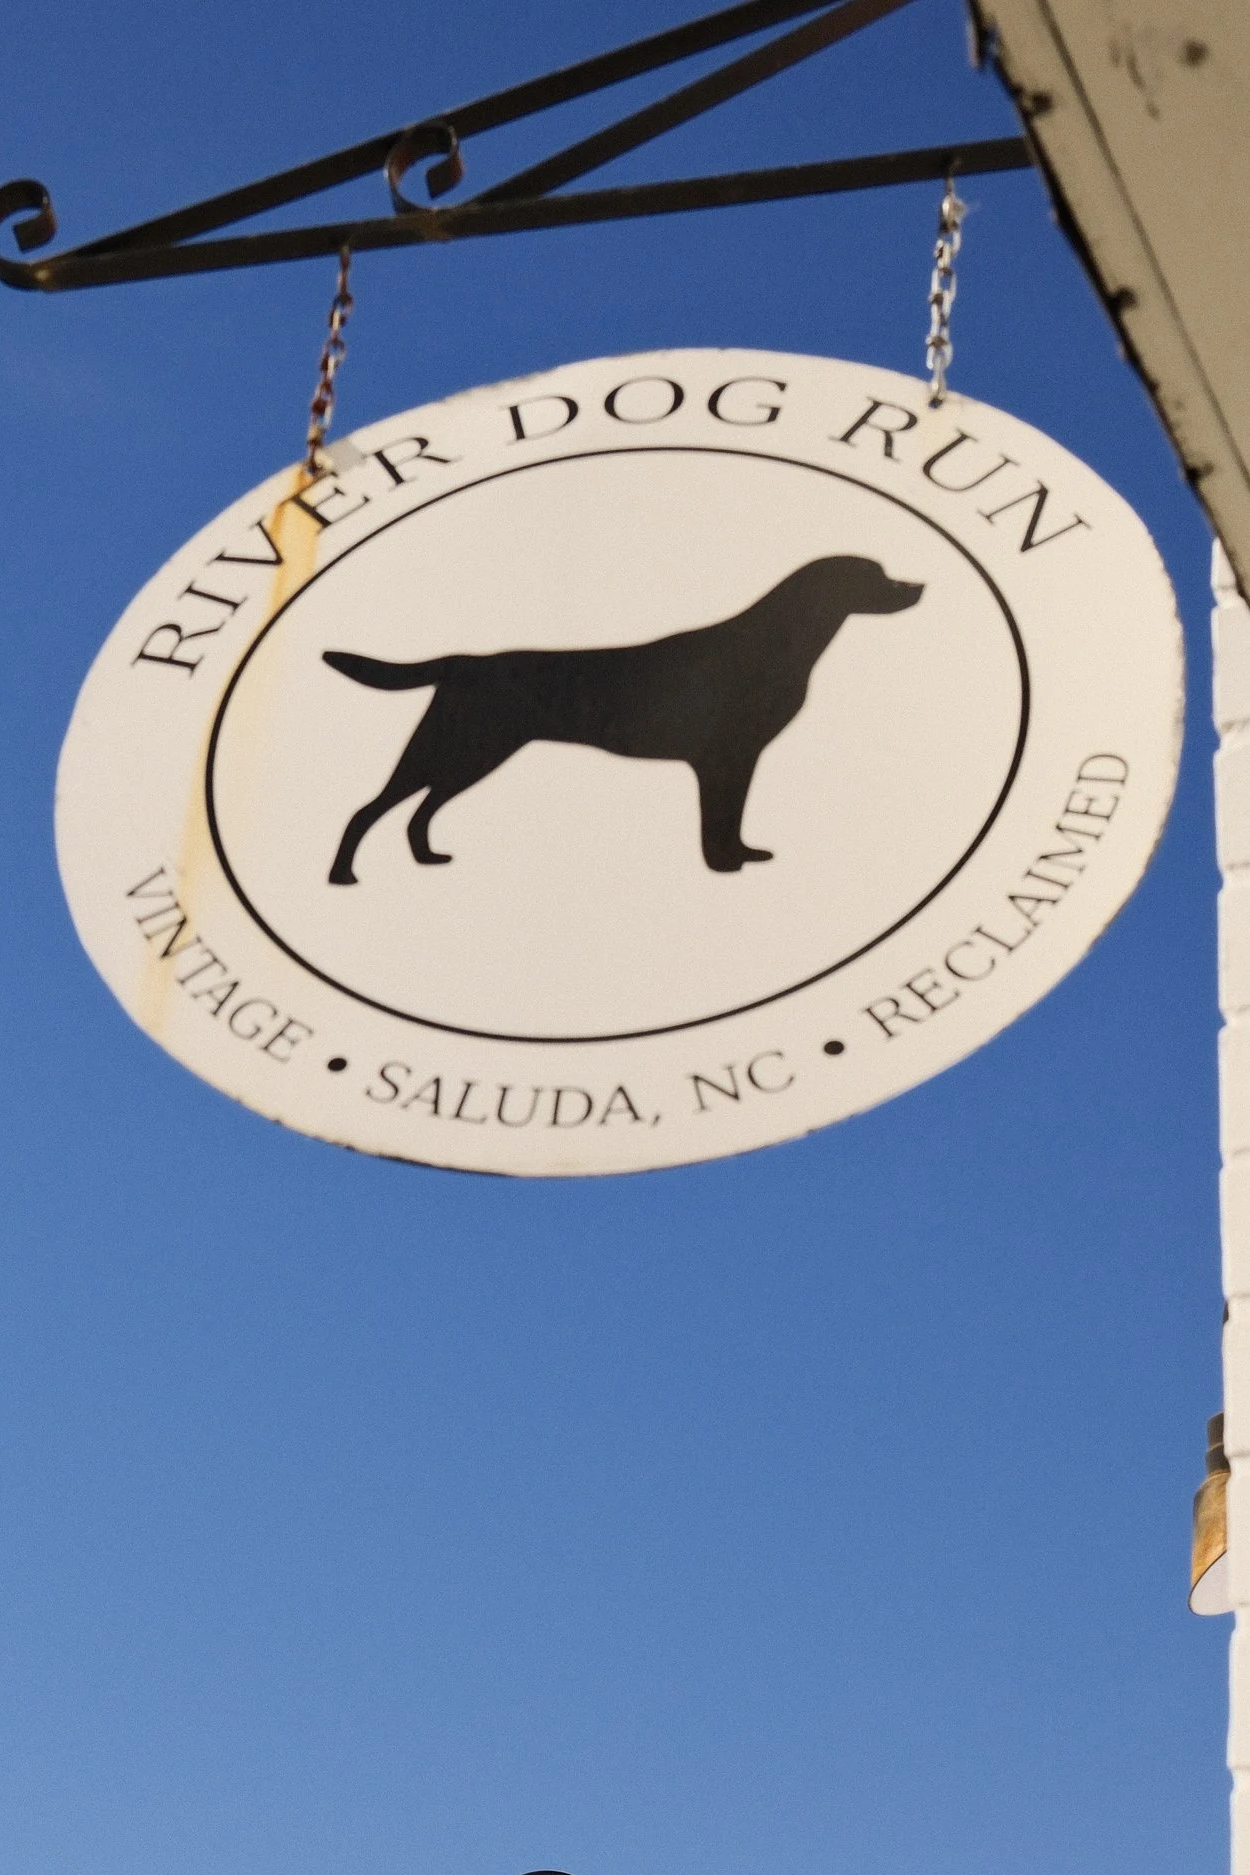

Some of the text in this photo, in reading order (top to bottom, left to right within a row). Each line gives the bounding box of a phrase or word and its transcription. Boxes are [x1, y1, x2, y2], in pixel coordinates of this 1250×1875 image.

[131, 375, 1093, 678] RIVER DOG RUN
[126, 866, 313, 1065] VINTAGE
[861, 750, 1130, 1043] RECLAIMED
[366, 1049, 797, 1130] SALUDA, NC
